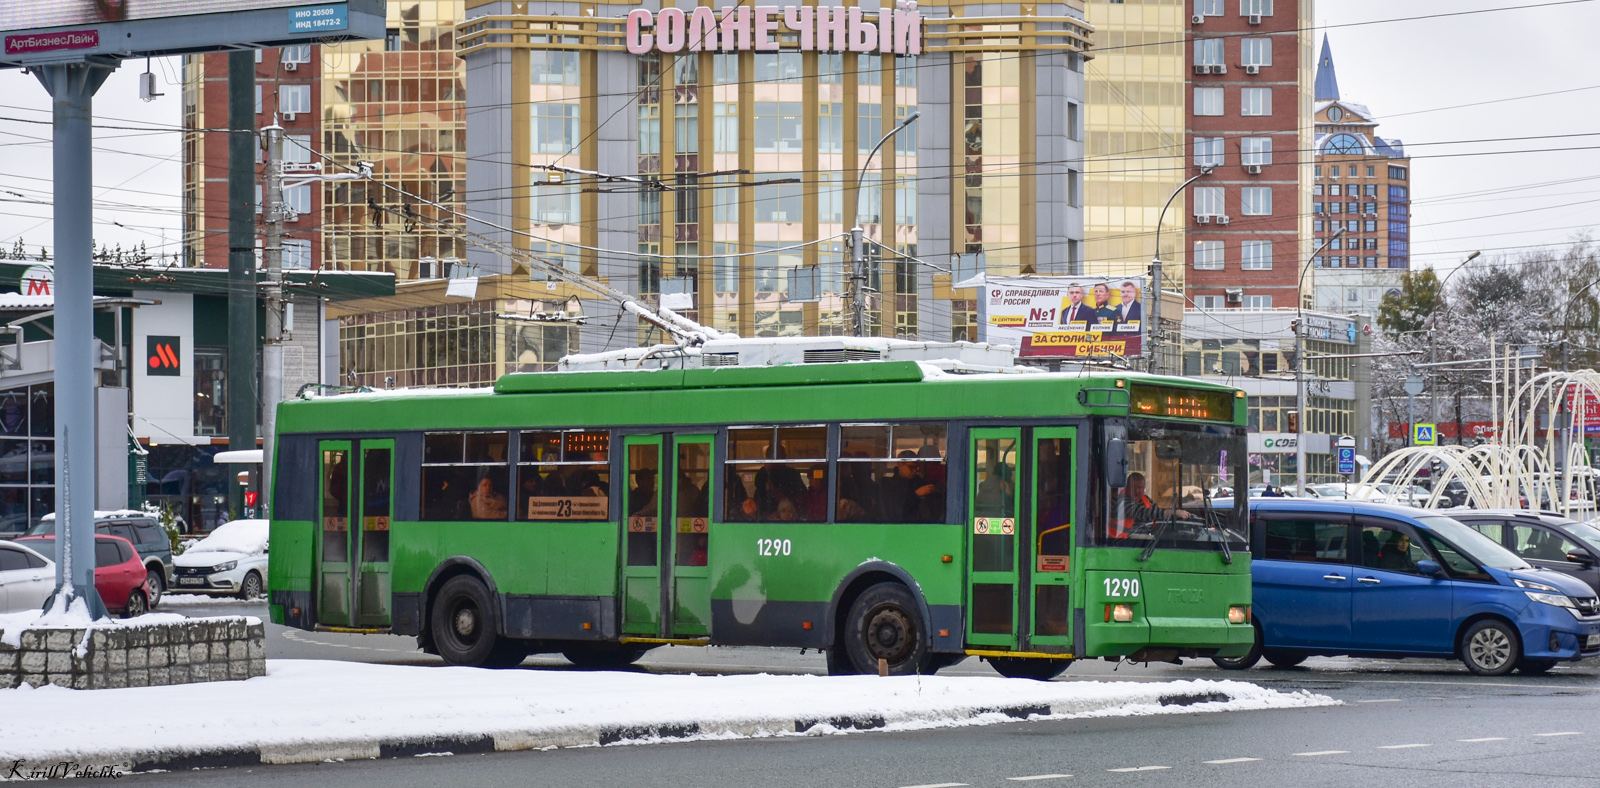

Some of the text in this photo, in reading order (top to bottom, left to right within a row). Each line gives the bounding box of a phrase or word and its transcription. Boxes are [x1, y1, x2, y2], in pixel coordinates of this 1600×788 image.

[295, 8, 334, 18] ИНО 20509
[295, 18, 341, 29] ИНД 18472-2
[626, 0, 921, 55] СОЛНЕЧНЫЙ
[9, 33, 95, 50] АртБизнесЛайн
[991, 289, 1001, 298] СР
[1005, 289, 1060, 298] СПРАВЕДЛИВАЯ
[1003, 298, 1031, 306] РОССИЯ
[1034, 335, 1048, 343] ЗА
[1079, 345, 1122, 353] СИБИРИ
[556, 499, 572, 517] 23
[757, 538, 792, 556] 1290
[1103, 577, 1139, 597] 1290
